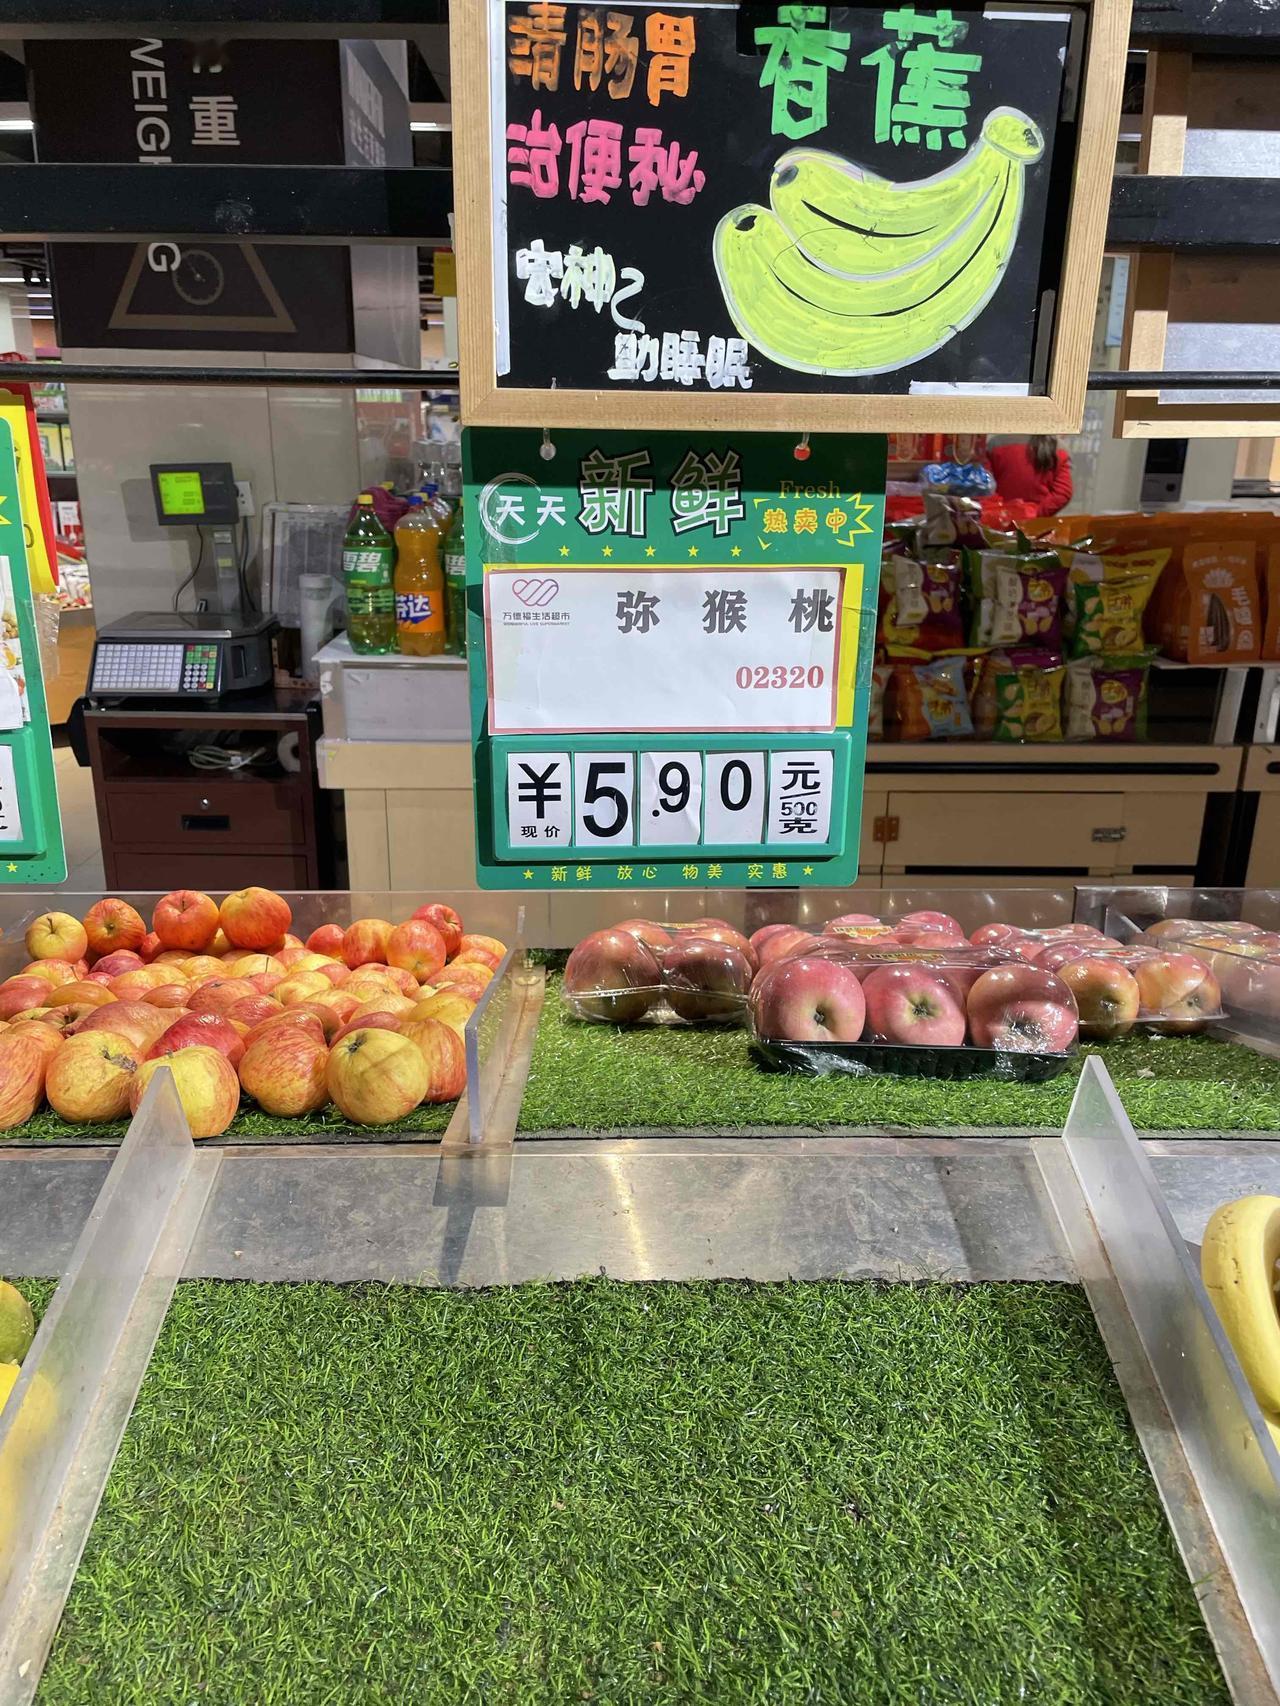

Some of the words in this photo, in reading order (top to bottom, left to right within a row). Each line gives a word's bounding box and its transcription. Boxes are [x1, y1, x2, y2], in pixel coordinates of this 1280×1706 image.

[509, 2, 696, 107] 清肠胃
[754, 5, 982, 151] 香蕉
[506, 108, 706, 206] 治便秘
[516, 239, 616, 314] 安神
[607, 330, 753, 389] 助睡眠
[495, 495, 566, 526] 天天
[577, 449, 745, 537] 新鲜
[778, 480, 841, 499] Fresh
[763, 507, 847, 535] 热卖中
[343, 550, 382, 573] 雪碧
[444, 553, 466, 576] 碧
[615, 588, 836, 634] 弥猴桃
[736, 665, 824, 689] 02320
[520, 825, 561, 839] 现价
[551, 866, 593, 882] 新鲜
[617, 865, 657, 880] 放心
[682, 864, 724, 880] 物美
[748, 863, 788, 879] 实惠
